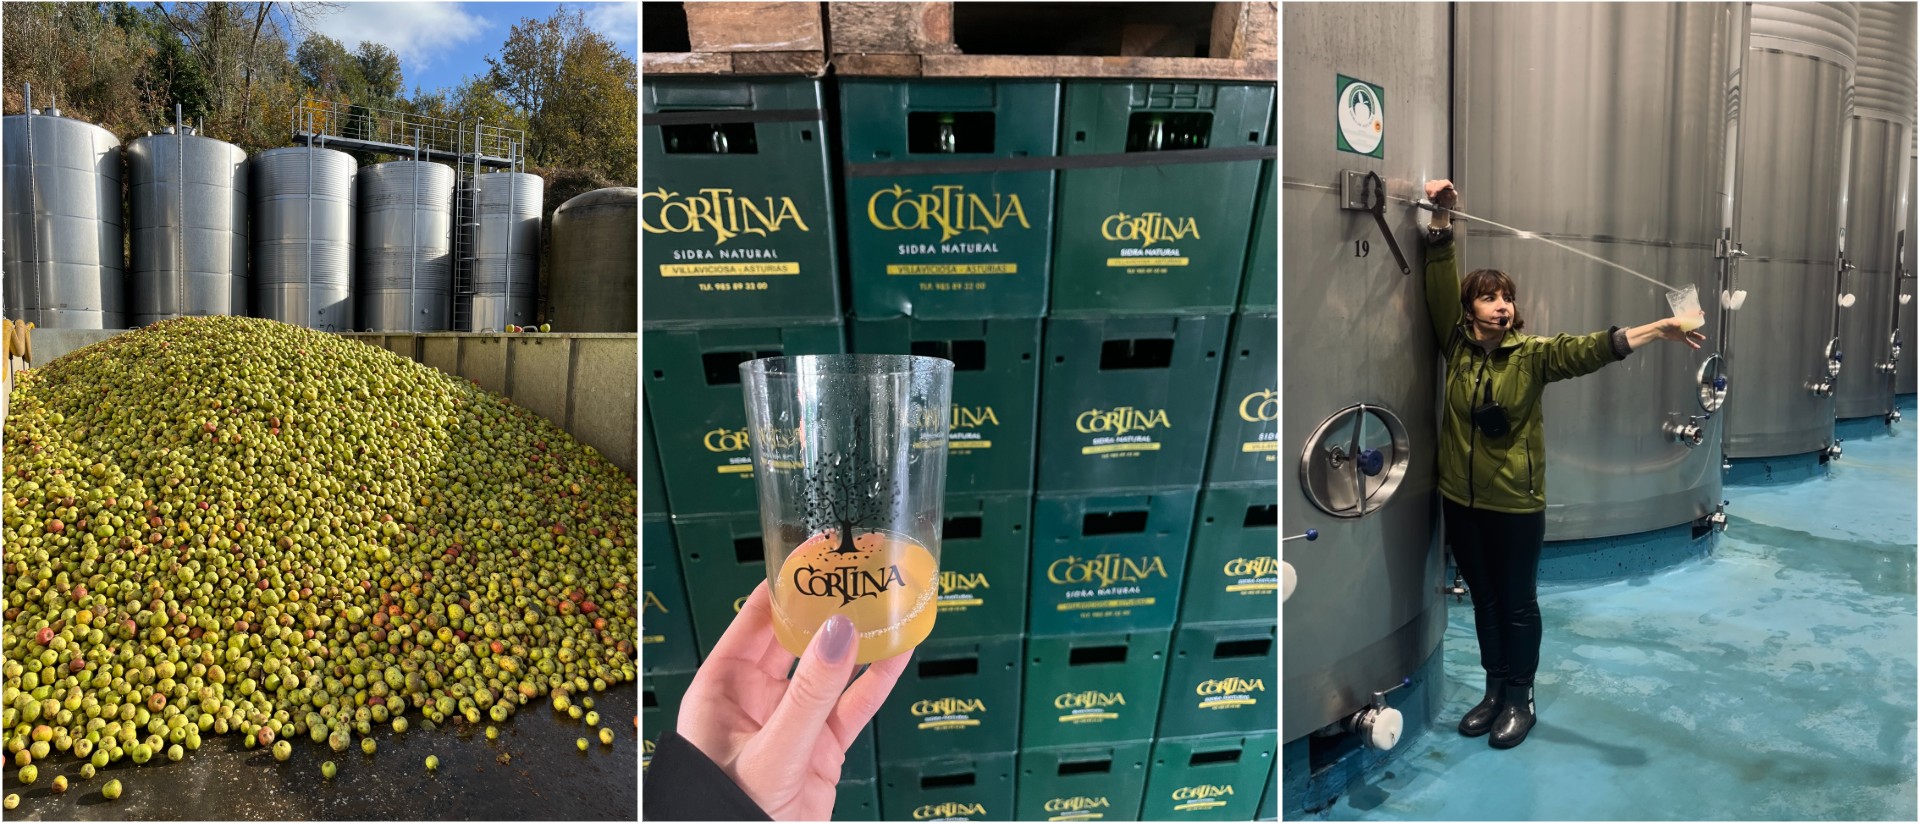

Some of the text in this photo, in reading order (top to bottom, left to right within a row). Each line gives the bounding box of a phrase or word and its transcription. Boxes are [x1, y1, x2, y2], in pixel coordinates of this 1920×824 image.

[643, 187, 809, 246] CORTINA
[867, 183, 1031, 243] CORTINA
[1101, 212, 1200, 248] CORTINA
[673, 249, 778, 260] SIDRA NATURAL
[898, 243, 999, 255] SIDRA NATURAL
[1354, 240, 1370, 258] 19
[671, 265, 737, 274] VILLAVICIOSA
[743, 265, 788, 273] ASTURIAS
[1076, 406, 1172, 435] CORTINA
[1047, 553, 1168, 588] CORTINA
[1223, 556, 1278, 578] CORTIN
[793, 563, 906, 608] CORTINA
[1196, 677, 1265, 696] CORTINA
[911, 697, 986, 716] CORTINA
[1054, 690, 1127, 709] CORTINA
